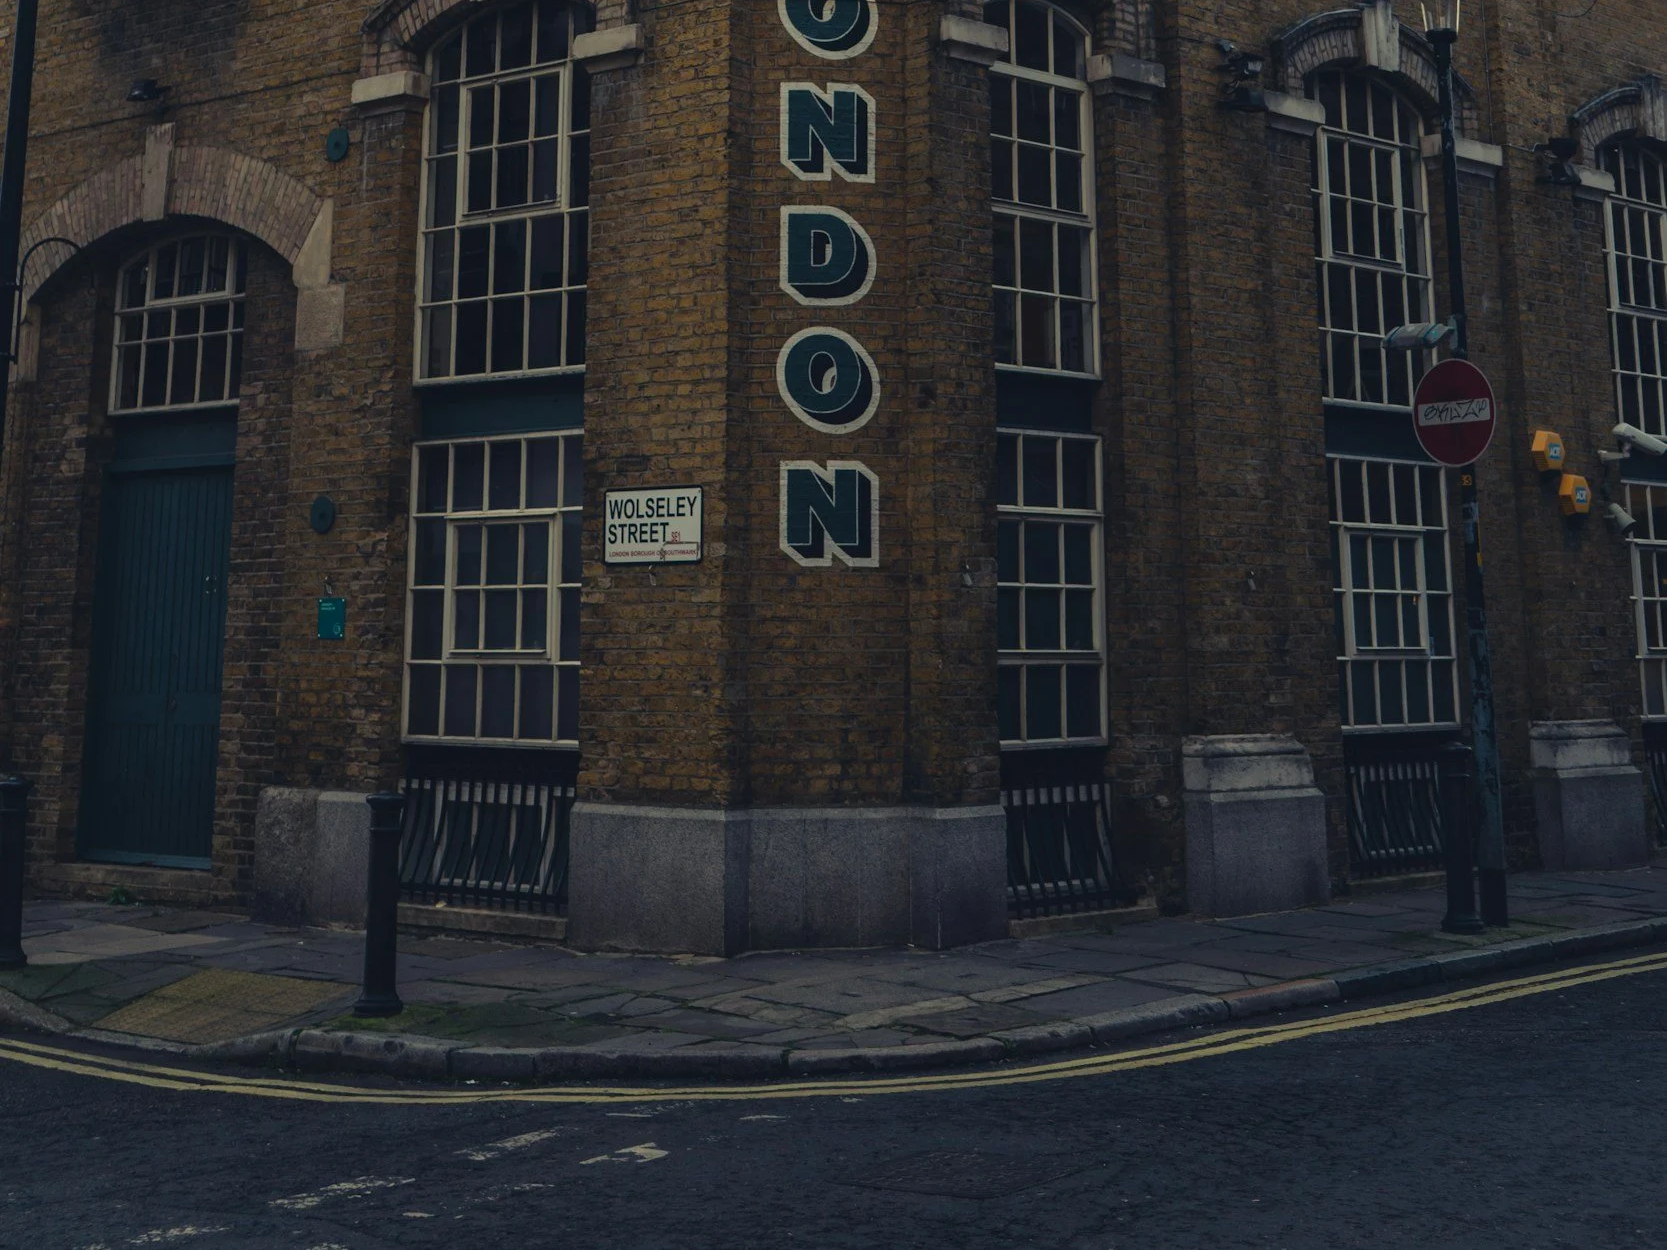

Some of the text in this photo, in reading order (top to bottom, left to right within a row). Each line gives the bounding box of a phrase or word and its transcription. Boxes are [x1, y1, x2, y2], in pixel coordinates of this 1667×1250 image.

[609, 496, 697, 520] WOLSELEY
[608, 522, 681, 544] STREET SE1
